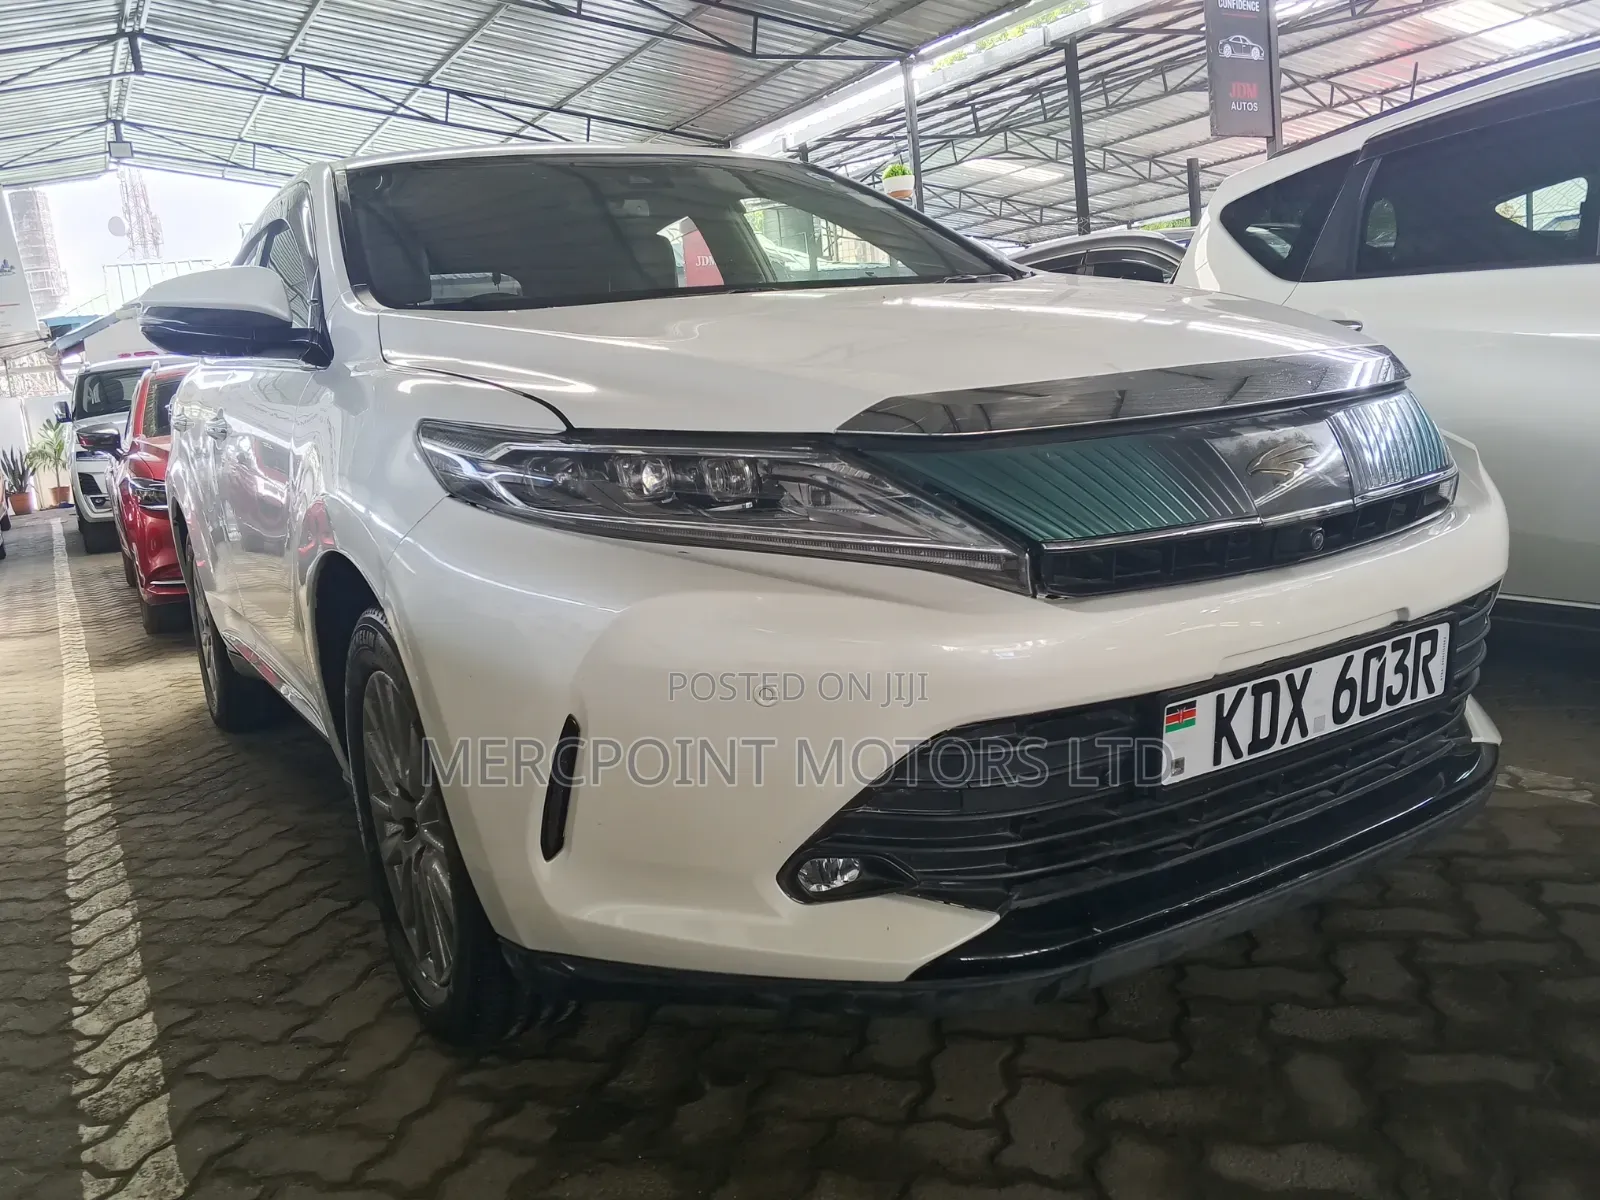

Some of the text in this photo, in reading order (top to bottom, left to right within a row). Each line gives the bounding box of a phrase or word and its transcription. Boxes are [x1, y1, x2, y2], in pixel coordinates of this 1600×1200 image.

[1218, 0, 1260, 12] CONFIDENCE
[1230, 82, 1257, 98] JDM
[1231, 101, 1258, 112] AUTOS
[1212, 667, 1313, 767] KDX
[1332, 628, 1439, 726] 603R
